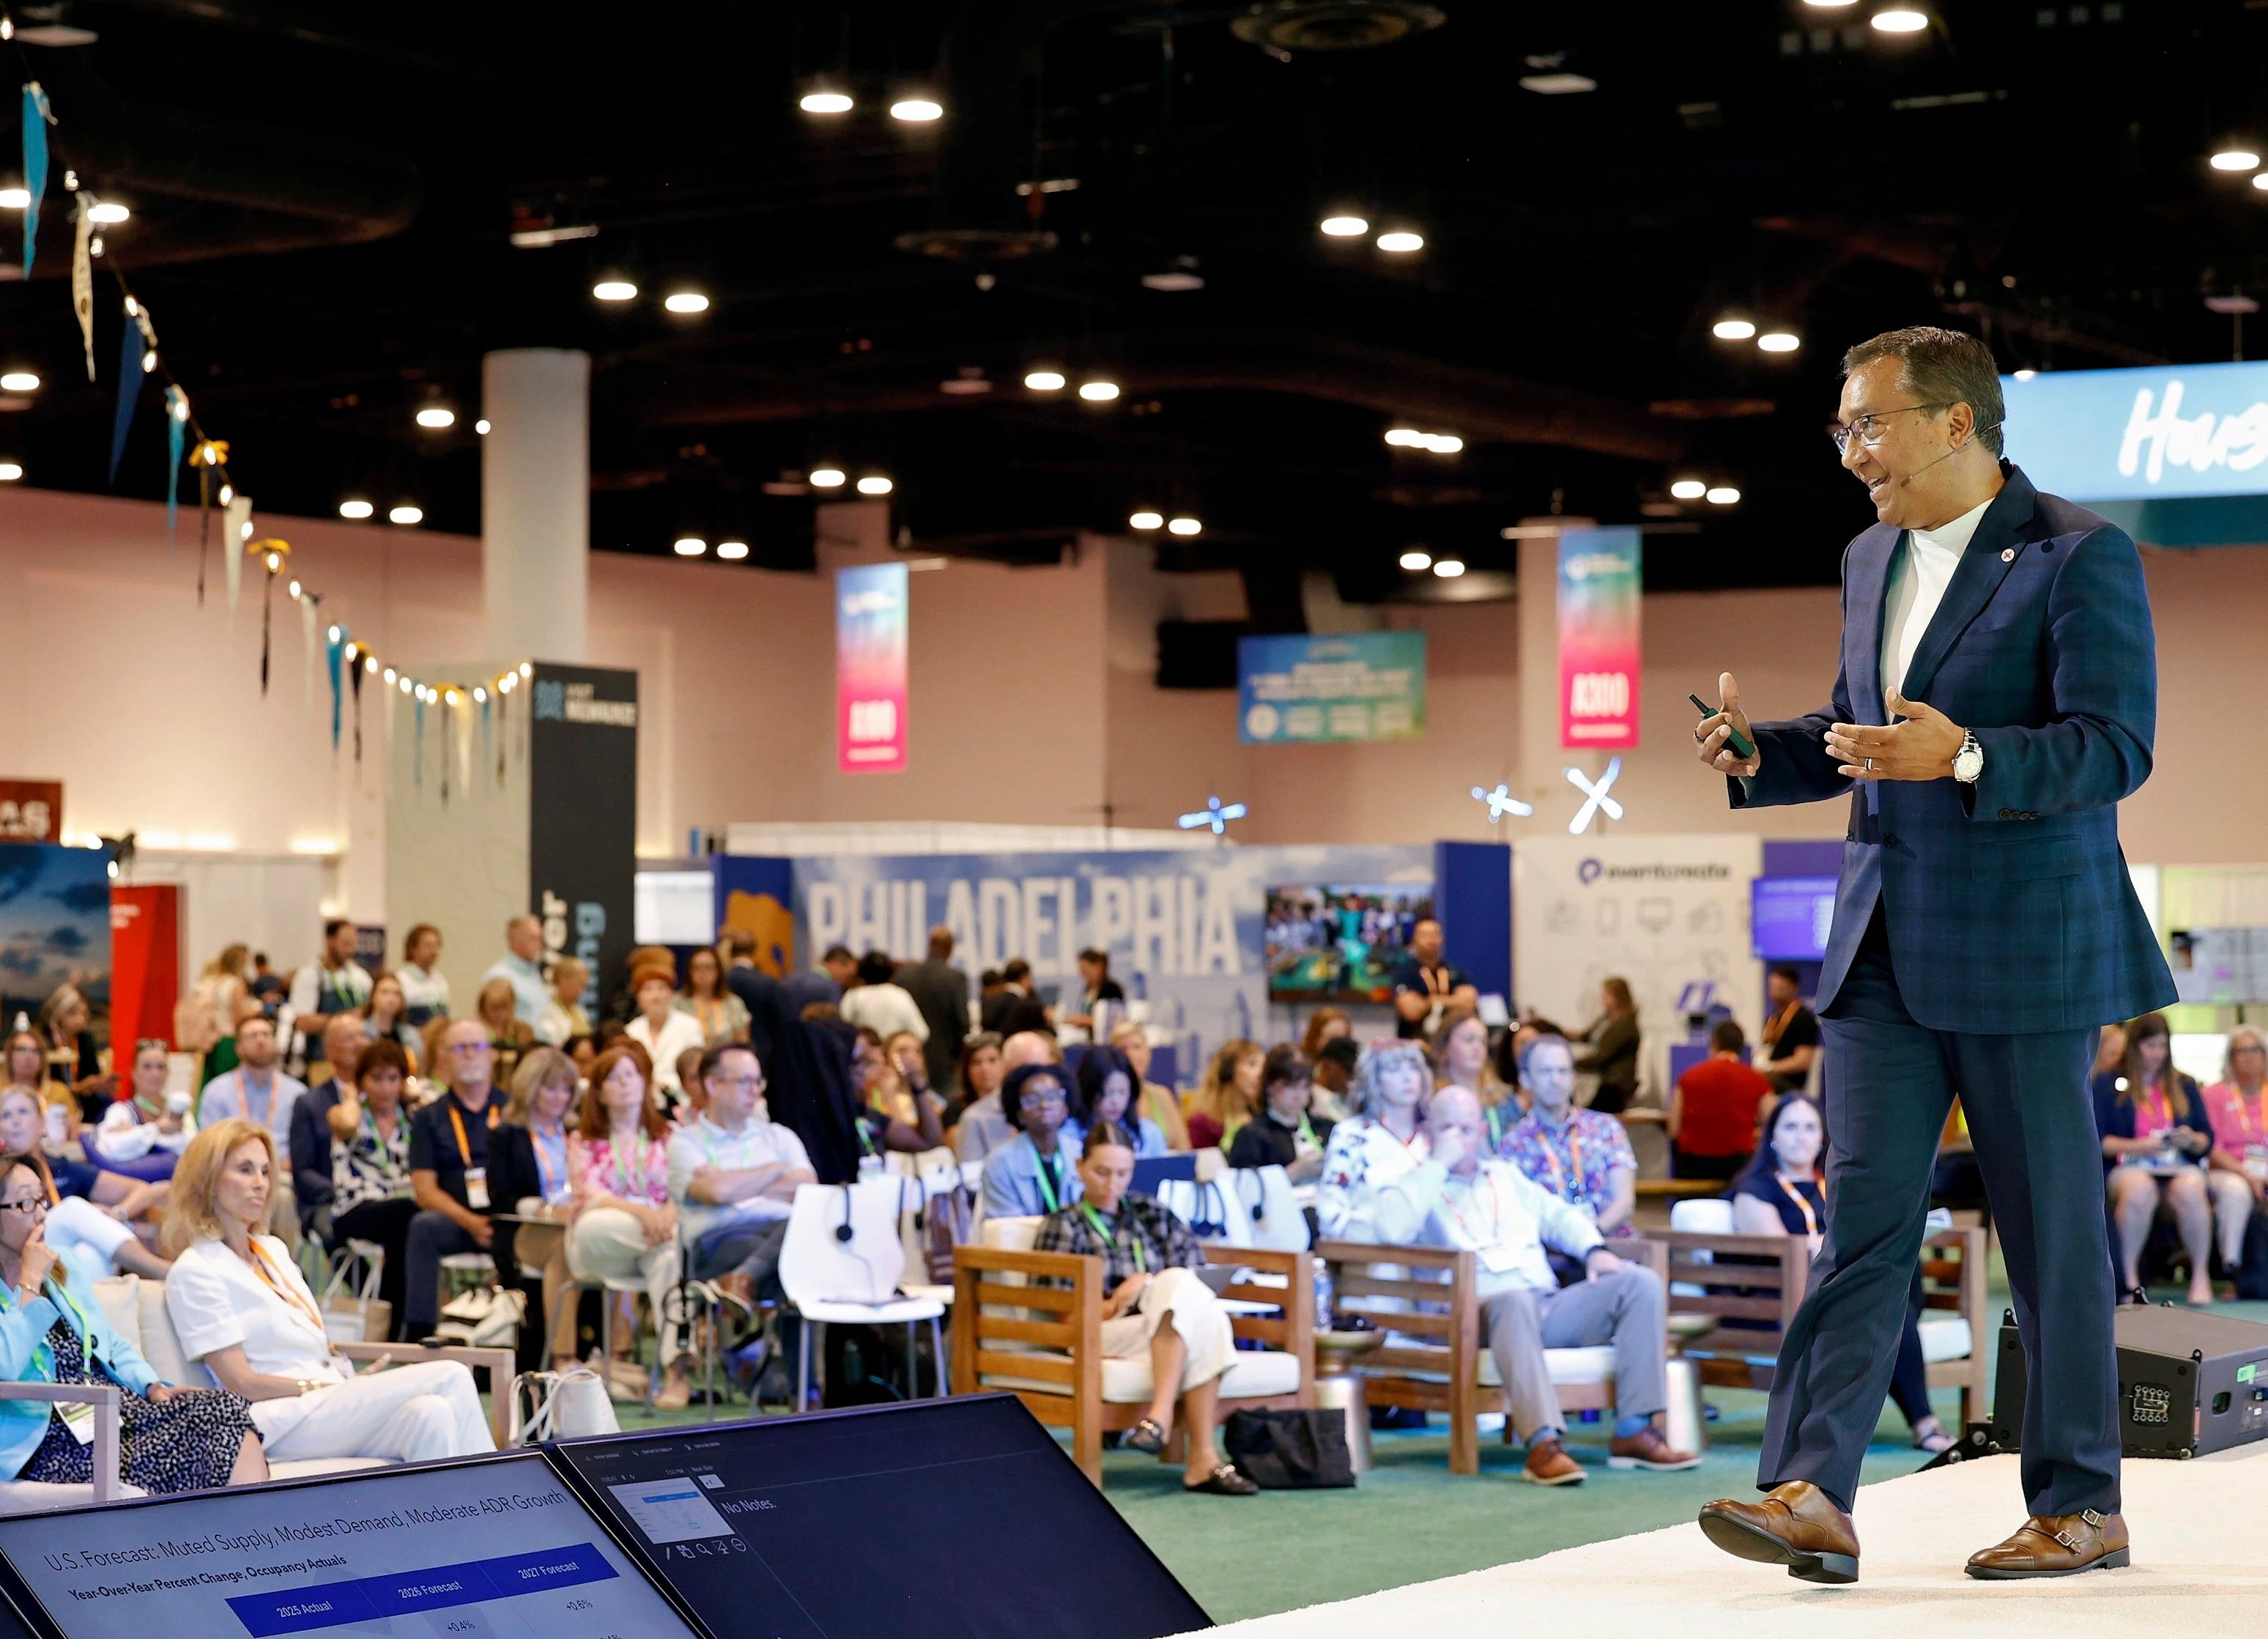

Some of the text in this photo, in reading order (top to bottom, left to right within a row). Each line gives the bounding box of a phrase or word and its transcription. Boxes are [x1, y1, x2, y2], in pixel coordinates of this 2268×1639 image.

[721, 1498, 778, 1514] No Notes.
[44, 1489, 568, 1572] U.S. Forecast: Muted Supply, Modest Demand, Moderate ADR Growth
[68, 1554, 347, 1601] Year-Over-Year Percent Change, Occupancy Actuals
[518, 1561, 580, 1580] 2027 Forecast
[398, 1580, 463, 1599] 2026 Forecast
[276, 1600, 334, 1618] 2025 Actual
[566, 1599, 593, 1612] +0.6%
[447, 1618, 475, 1632] +0.4%
